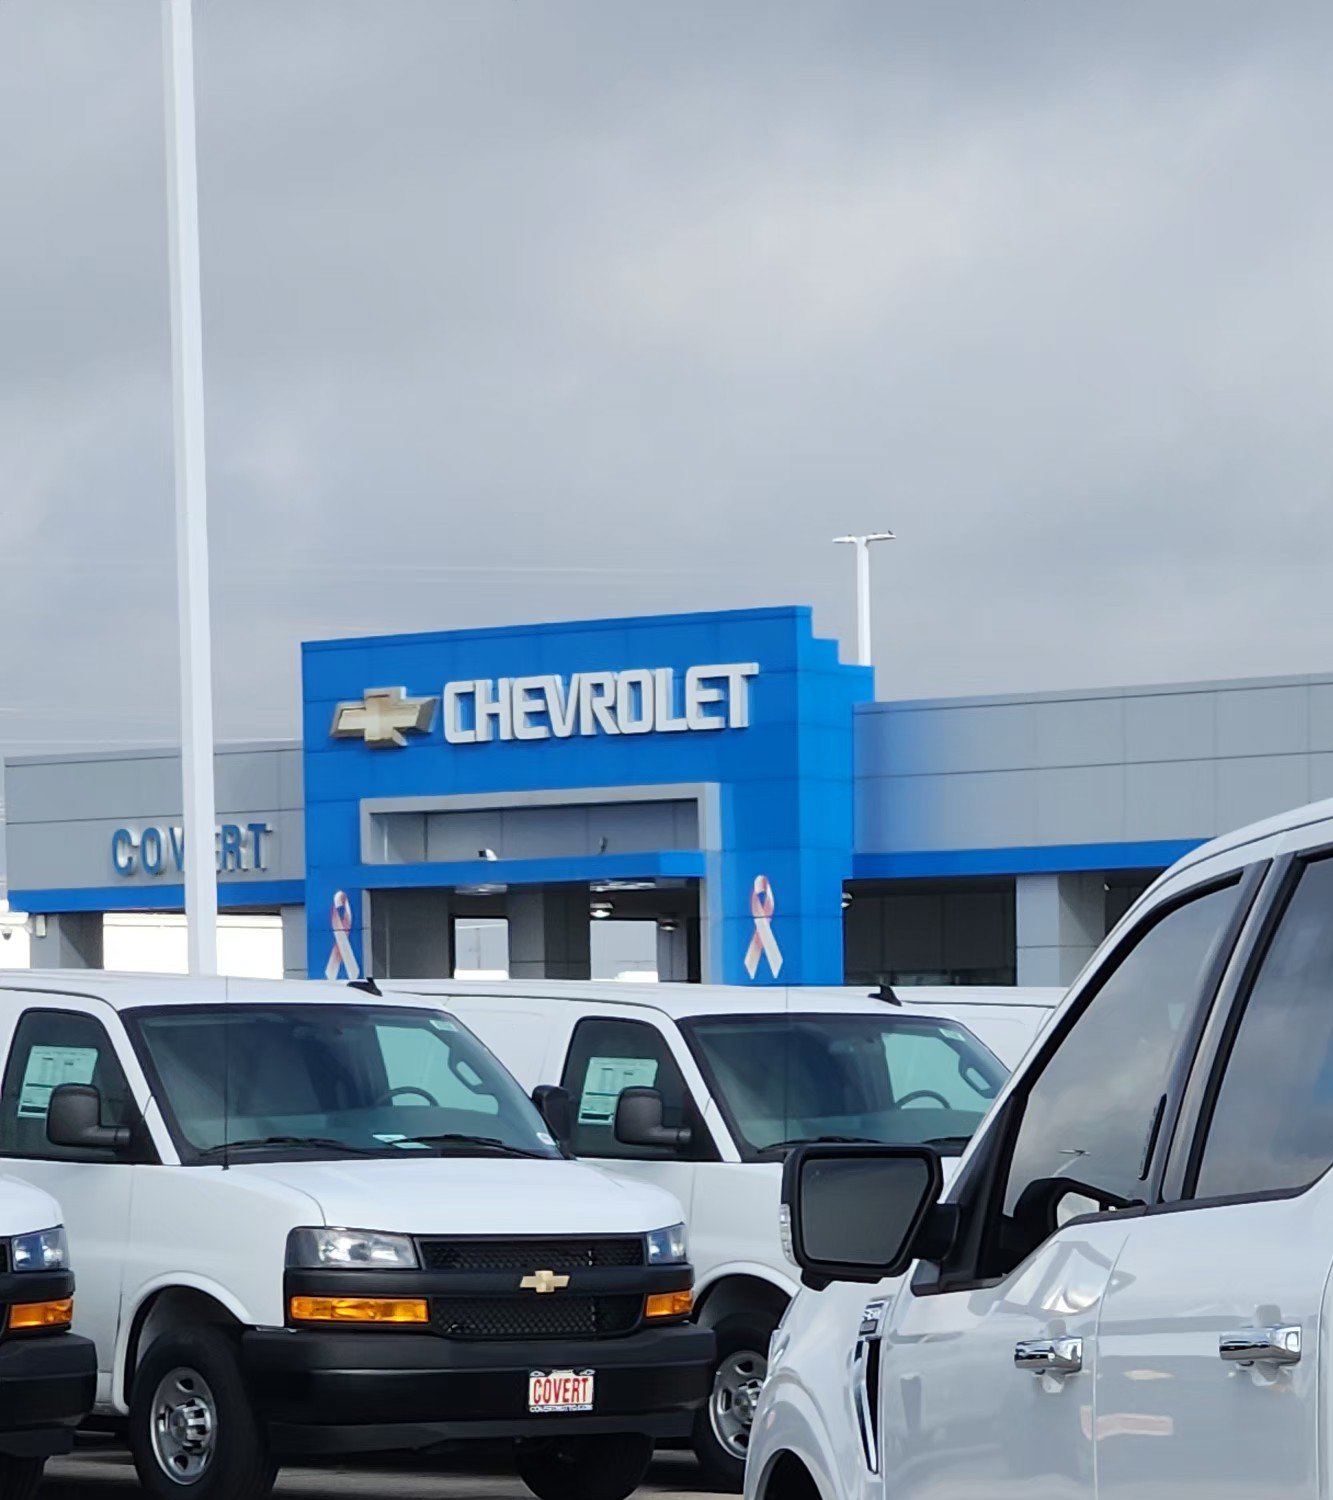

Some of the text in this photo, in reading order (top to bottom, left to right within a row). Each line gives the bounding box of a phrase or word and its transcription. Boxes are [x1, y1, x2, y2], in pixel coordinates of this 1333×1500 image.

[443, 662, 760, 744] CHEVROLET
[111, 823, 272, 877] COVRT
[533, 1377, 589, 1405] COVERT
